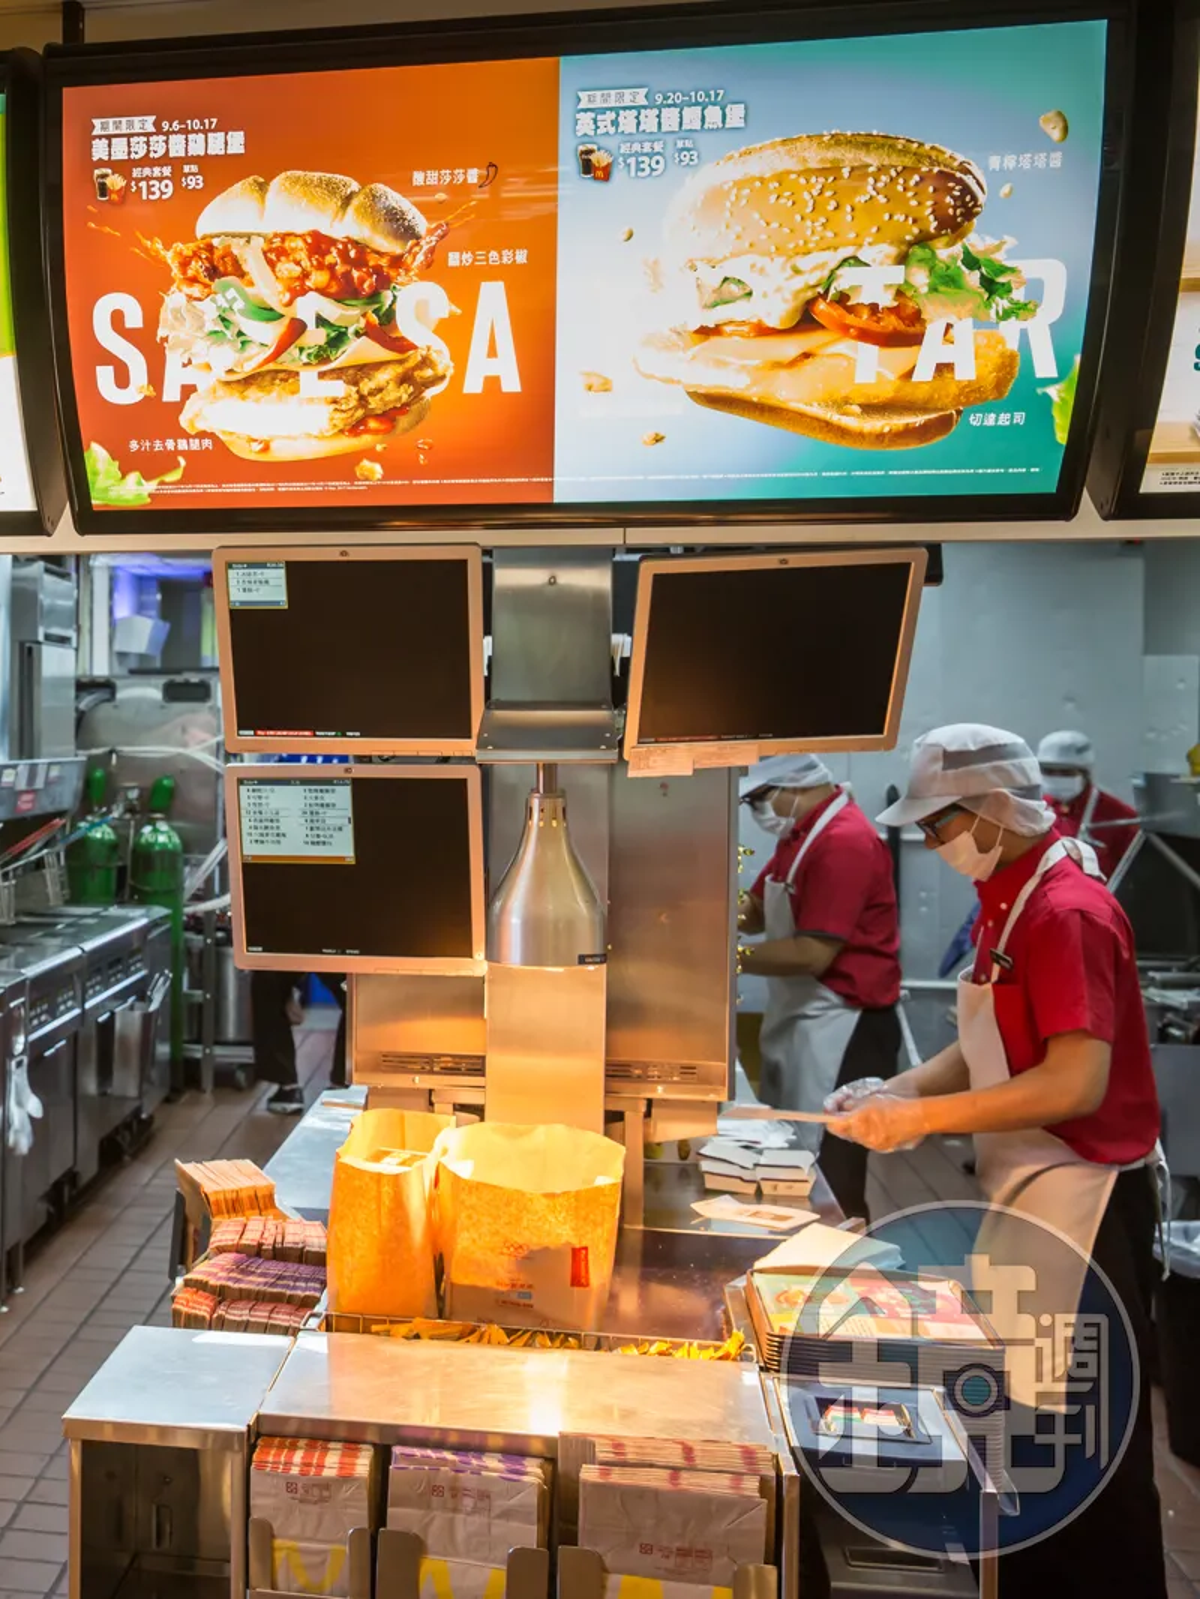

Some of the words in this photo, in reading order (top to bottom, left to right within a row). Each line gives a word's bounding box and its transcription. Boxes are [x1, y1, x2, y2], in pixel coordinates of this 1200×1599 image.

[617, 155, 666, 179] $139
[673, 151, 699, 166] $93
[130, 179, 174, 201] $139
[181, 175, 205, 190] $93
